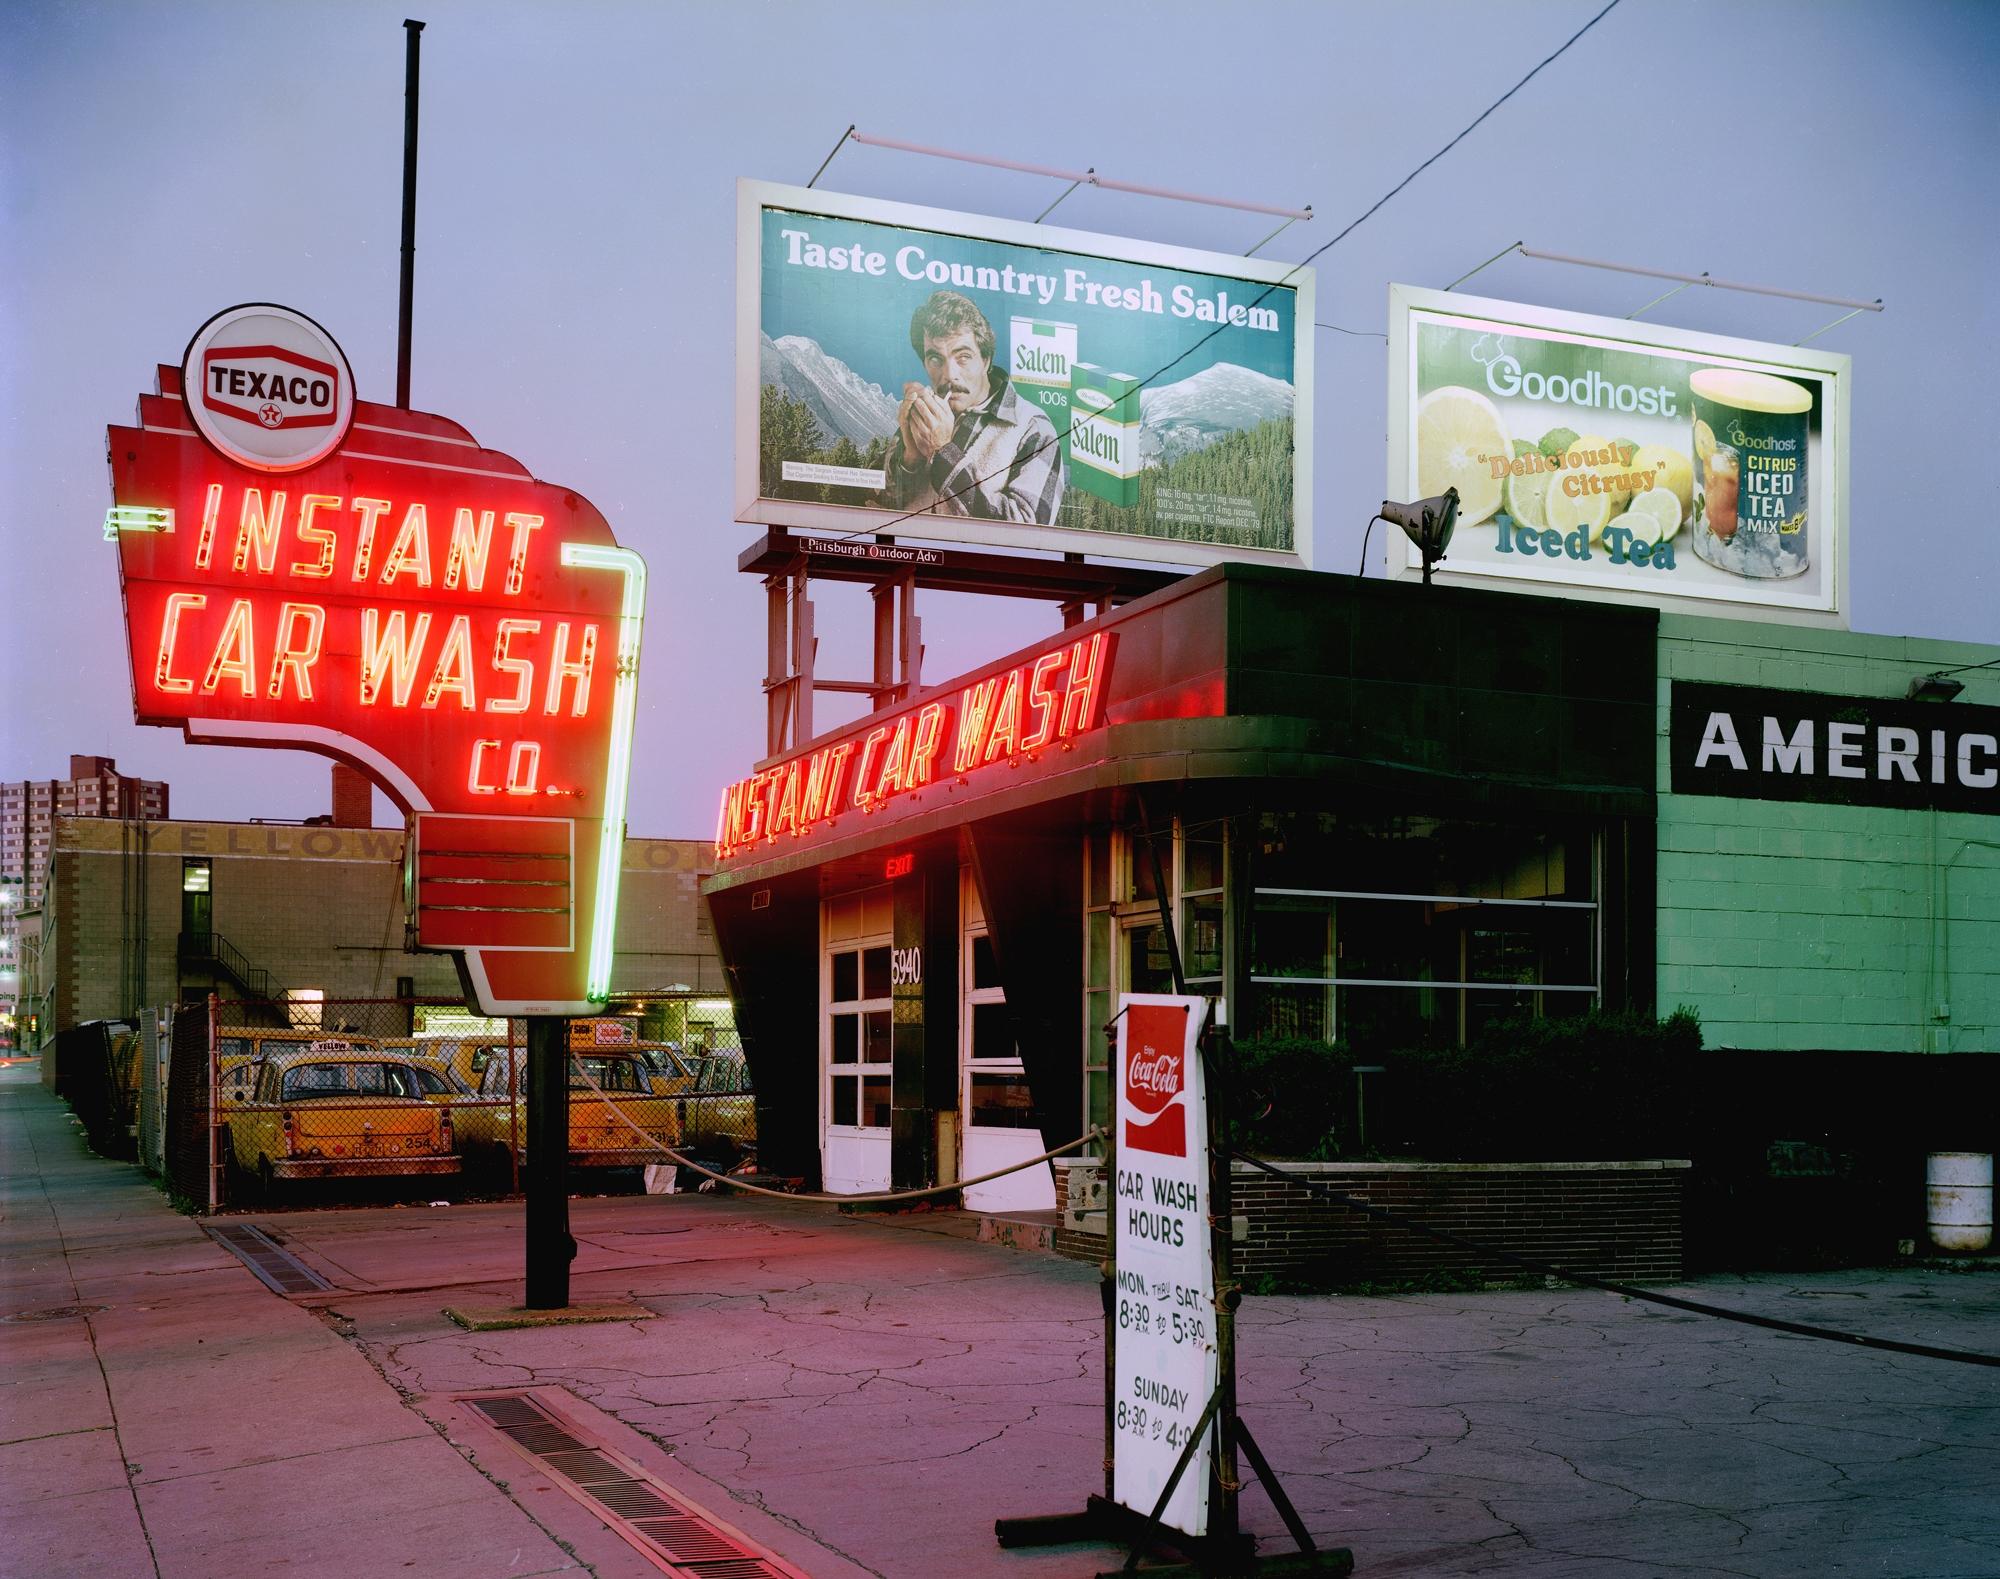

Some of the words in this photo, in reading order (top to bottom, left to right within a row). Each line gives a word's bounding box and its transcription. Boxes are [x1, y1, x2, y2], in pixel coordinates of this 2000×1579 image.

[781, 229, 886, 276] Taste
[896, 246, 1057, 305] Country
[1064, 268, 1164, 314] Fresh
[1171, 284, 1279, 333] Salem
[1016, 344, 1067, 375] Salem
[210, 366, 330, 407] TEXACO
[1038, 390, 1068, 406] 100's
[1486, 355, 1677, 417] Goodhost
[1072, 417, 1120, 464] Salem
[1732, 430, 1796, 451] Goodhost
[1748, 455, 1796, 472] CITRUS
[1747, 472, 1793, 495] ICED
[1175, 500, 1184, 510] 20
[1202, 513, 1214, 524] FTC
[1748, 495, 1786, 518] TEA
[194, 483, 545, 595] INSTANT
[1494, 514, 1592, 561] Iced
[1601, 526, 1676, 570] Tea
[1747, 518, 1778, 534] MIX
[808, 538, 866, 557] Pittsburgh
[869, 545, 915, 560] Outdoor
[916, 550, 937, 562] Adv
[154, 593, 326, 702] CAR
[360, 608, 599, 718] WASH
[714, 741, 850, 854] INSTANT
[854, 703, 943, 806] CAR
[955, 633, 1102, 772] WASH
[1694, 711, 2000, 789] AMERIC
[886, 854, 914, 878] EXIT
[891, 946, 920, 984] 5940
[318, 1042, 346, 1050] YELLOW
[1129, 1052, 1181, 1093] Coca-Cola
[405, 1138, 432, 1149] 254
[1118, 1170, 1143, 1201] CAR
[1152, 1176, 1198, 1213] WASH
[1129, 1208, 1184, 1247] HOURS
[1118, 1269, 1148, 1296] MON.
[1152, 1282, 1170, 1296] THRU
[1176, 1285, 1203, 1312] SAT.
[1120, 1299, 1149, 1329] 8:30
[1156, 1314, 1166, 1329] to
[1173, 1312, 1204, 1344] 5:30
[1134, 1376, 1188, 1413] SUNDAY
[1117, 1400, 1146, 1430] 8:30
[1152, 1417, 1162, 1434] to
[1166, 1421, 1192, 1451] 4:0
